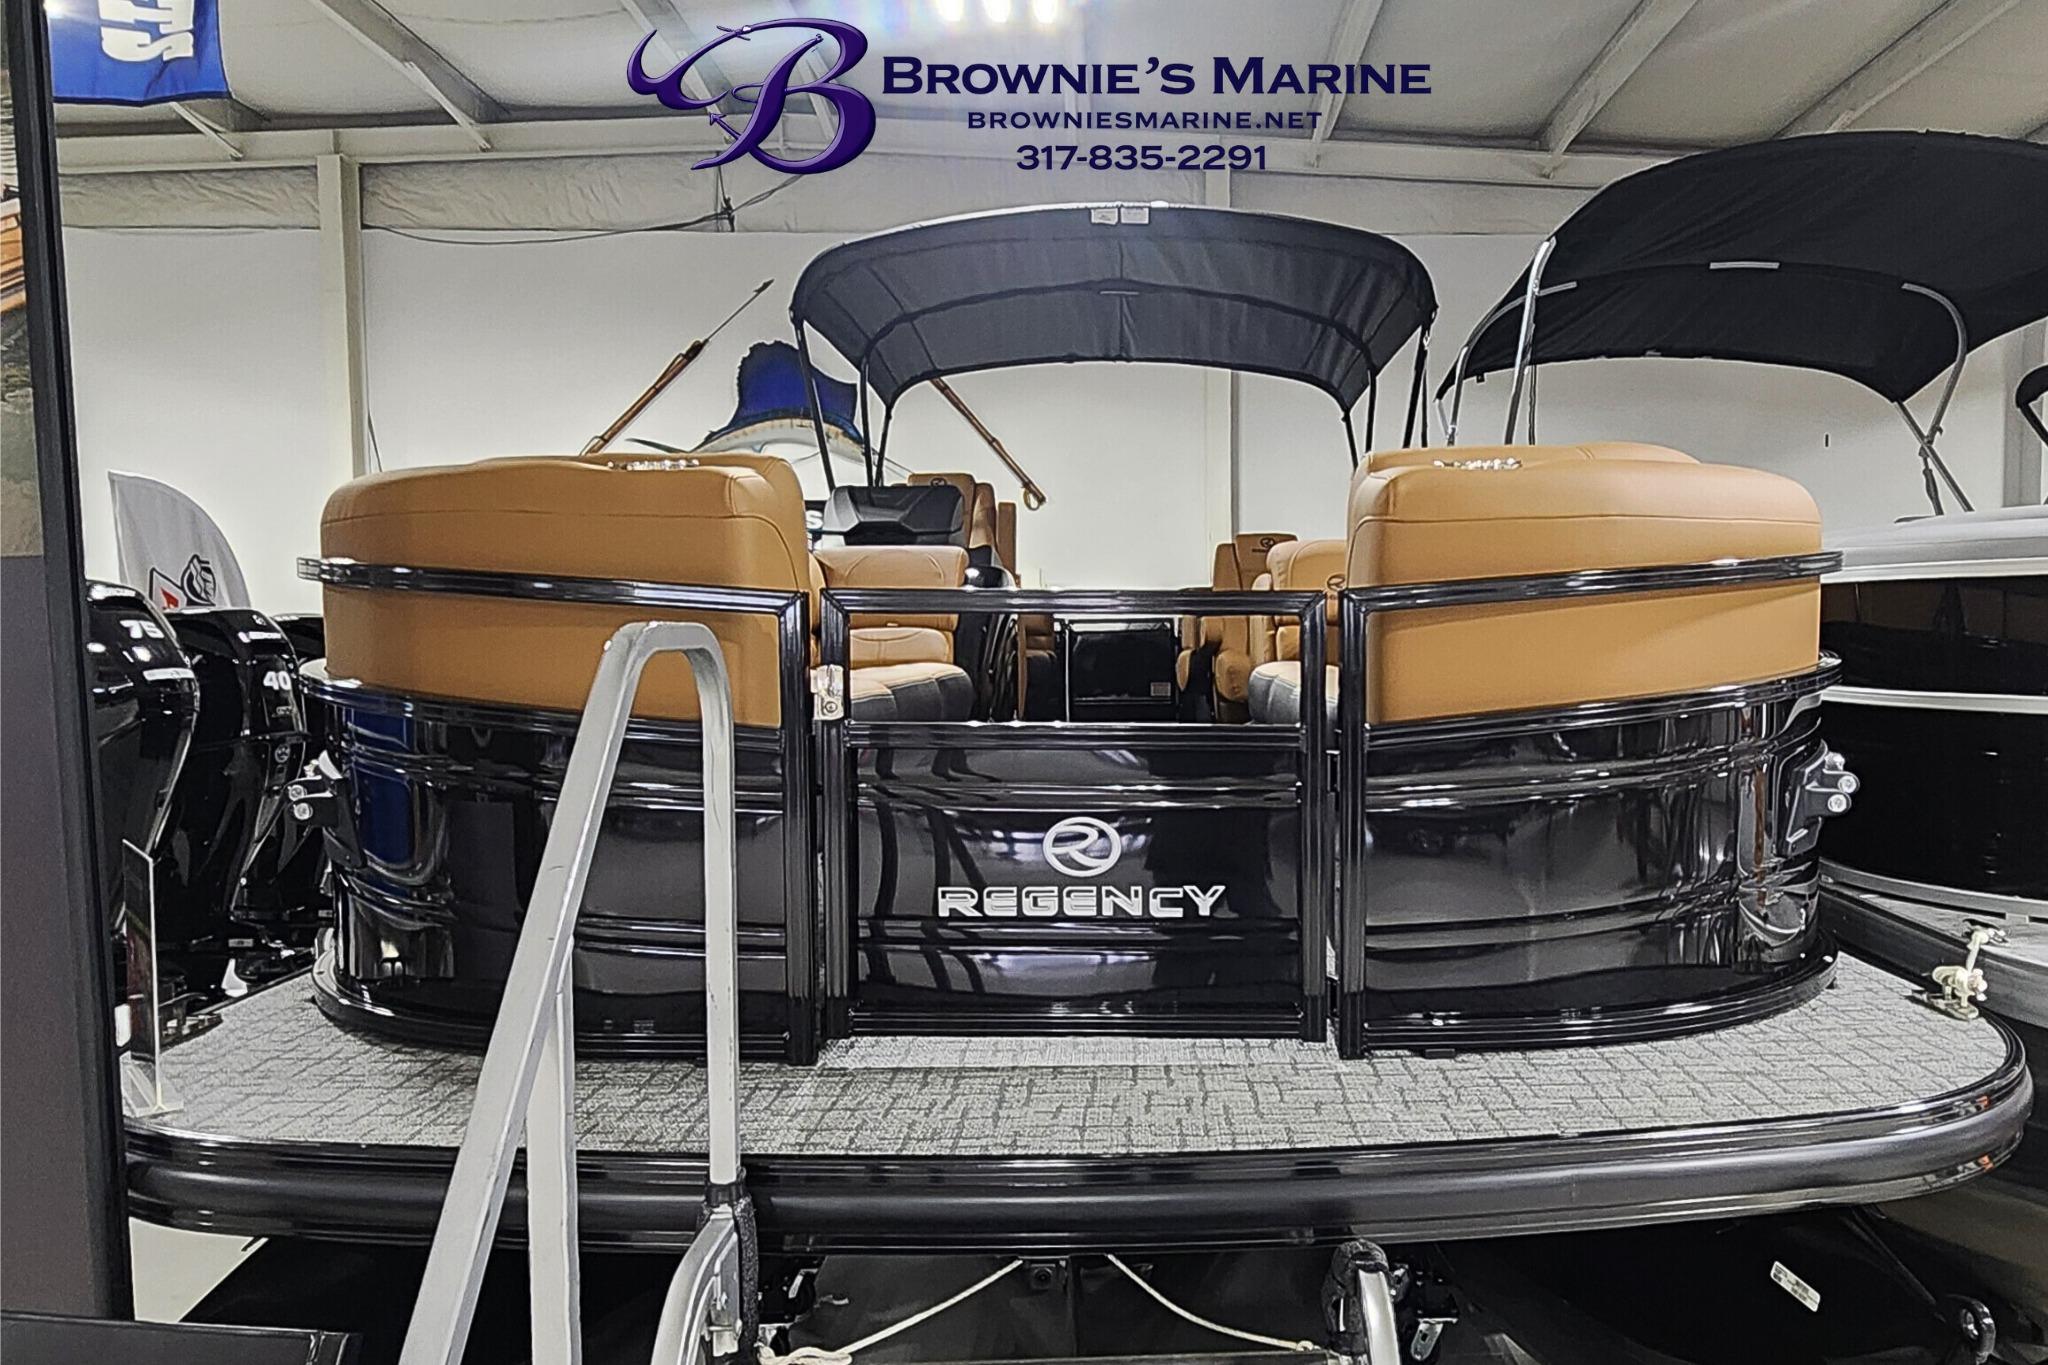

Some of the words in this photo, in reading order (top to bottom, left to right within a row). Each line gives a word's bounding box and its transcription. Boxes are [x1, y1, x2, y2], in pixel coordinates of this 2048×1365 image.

[98, 0, 194, 62] TS
[262, 670, 291, 691] 40
[937, 885, 1226, 918] REGENCY
